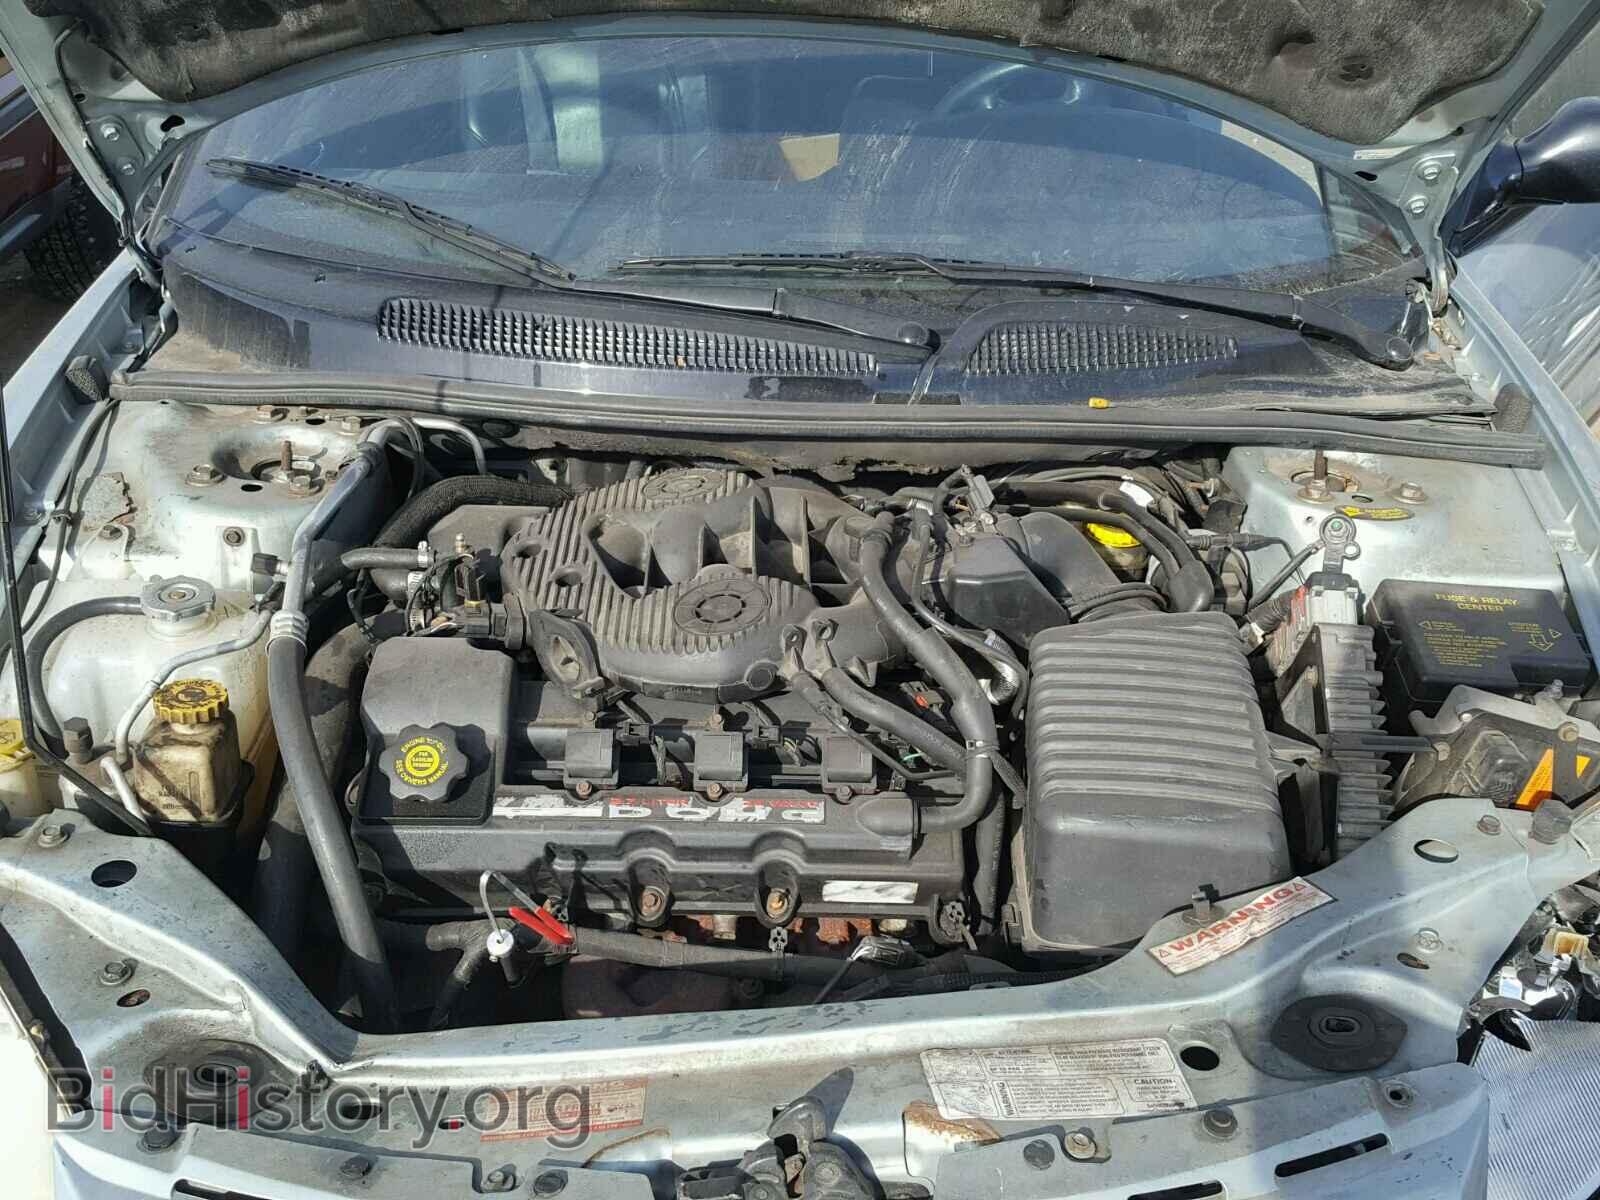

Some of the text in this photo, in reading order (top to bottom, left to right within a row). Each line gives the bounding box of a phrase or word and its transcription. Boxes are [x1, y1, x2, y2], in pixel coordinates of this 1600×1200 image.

[1435, 592, 1466, 602] FUSE
[1481, 597, 1518, 605] RELAY
[1456, 602, 1504, 611] CENTER
[400, 737, 427, 752] ENGINE
[427, 760, 449, 784] MANUAL
[1169, 887, 1294, 951] WARNING
